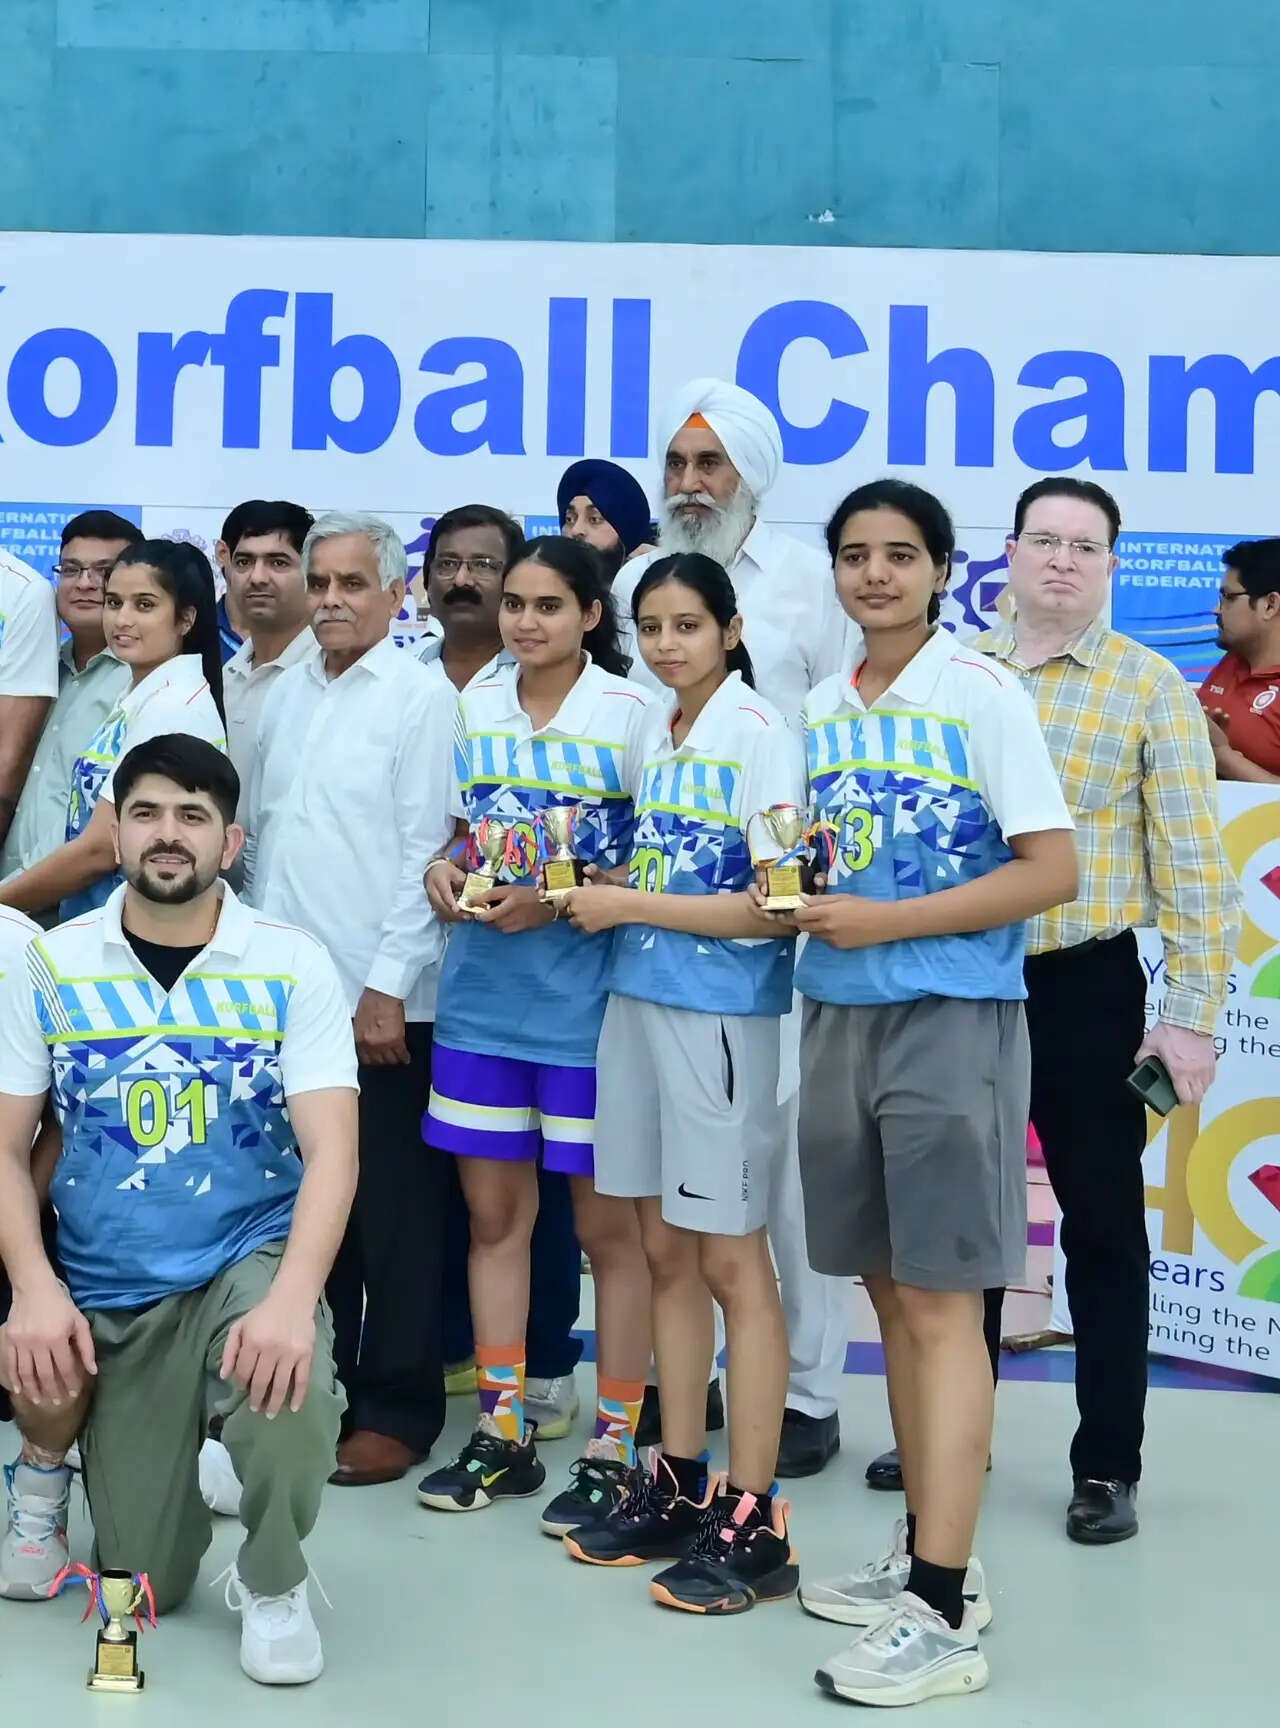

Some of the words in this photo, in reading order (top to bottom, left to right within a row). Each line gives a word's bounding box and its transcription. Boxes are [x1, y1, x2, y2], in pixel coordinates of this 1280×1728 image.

[735, 299, 1280, 475] Cham
[1120, 558, 1228, 573] KORFBALL
[1120, 574, 1221, 589] FEDERATI
[1225, 1008, 1269, 1030] the
[1239, 1036, 1280, 1058] the
[126, 1078, 207, 1146] 01
[1149, 1259, 1225, 1292] ears
[1212, 1307, 1256, 1331] the
[1225, 1336, 1270, 1361] the
